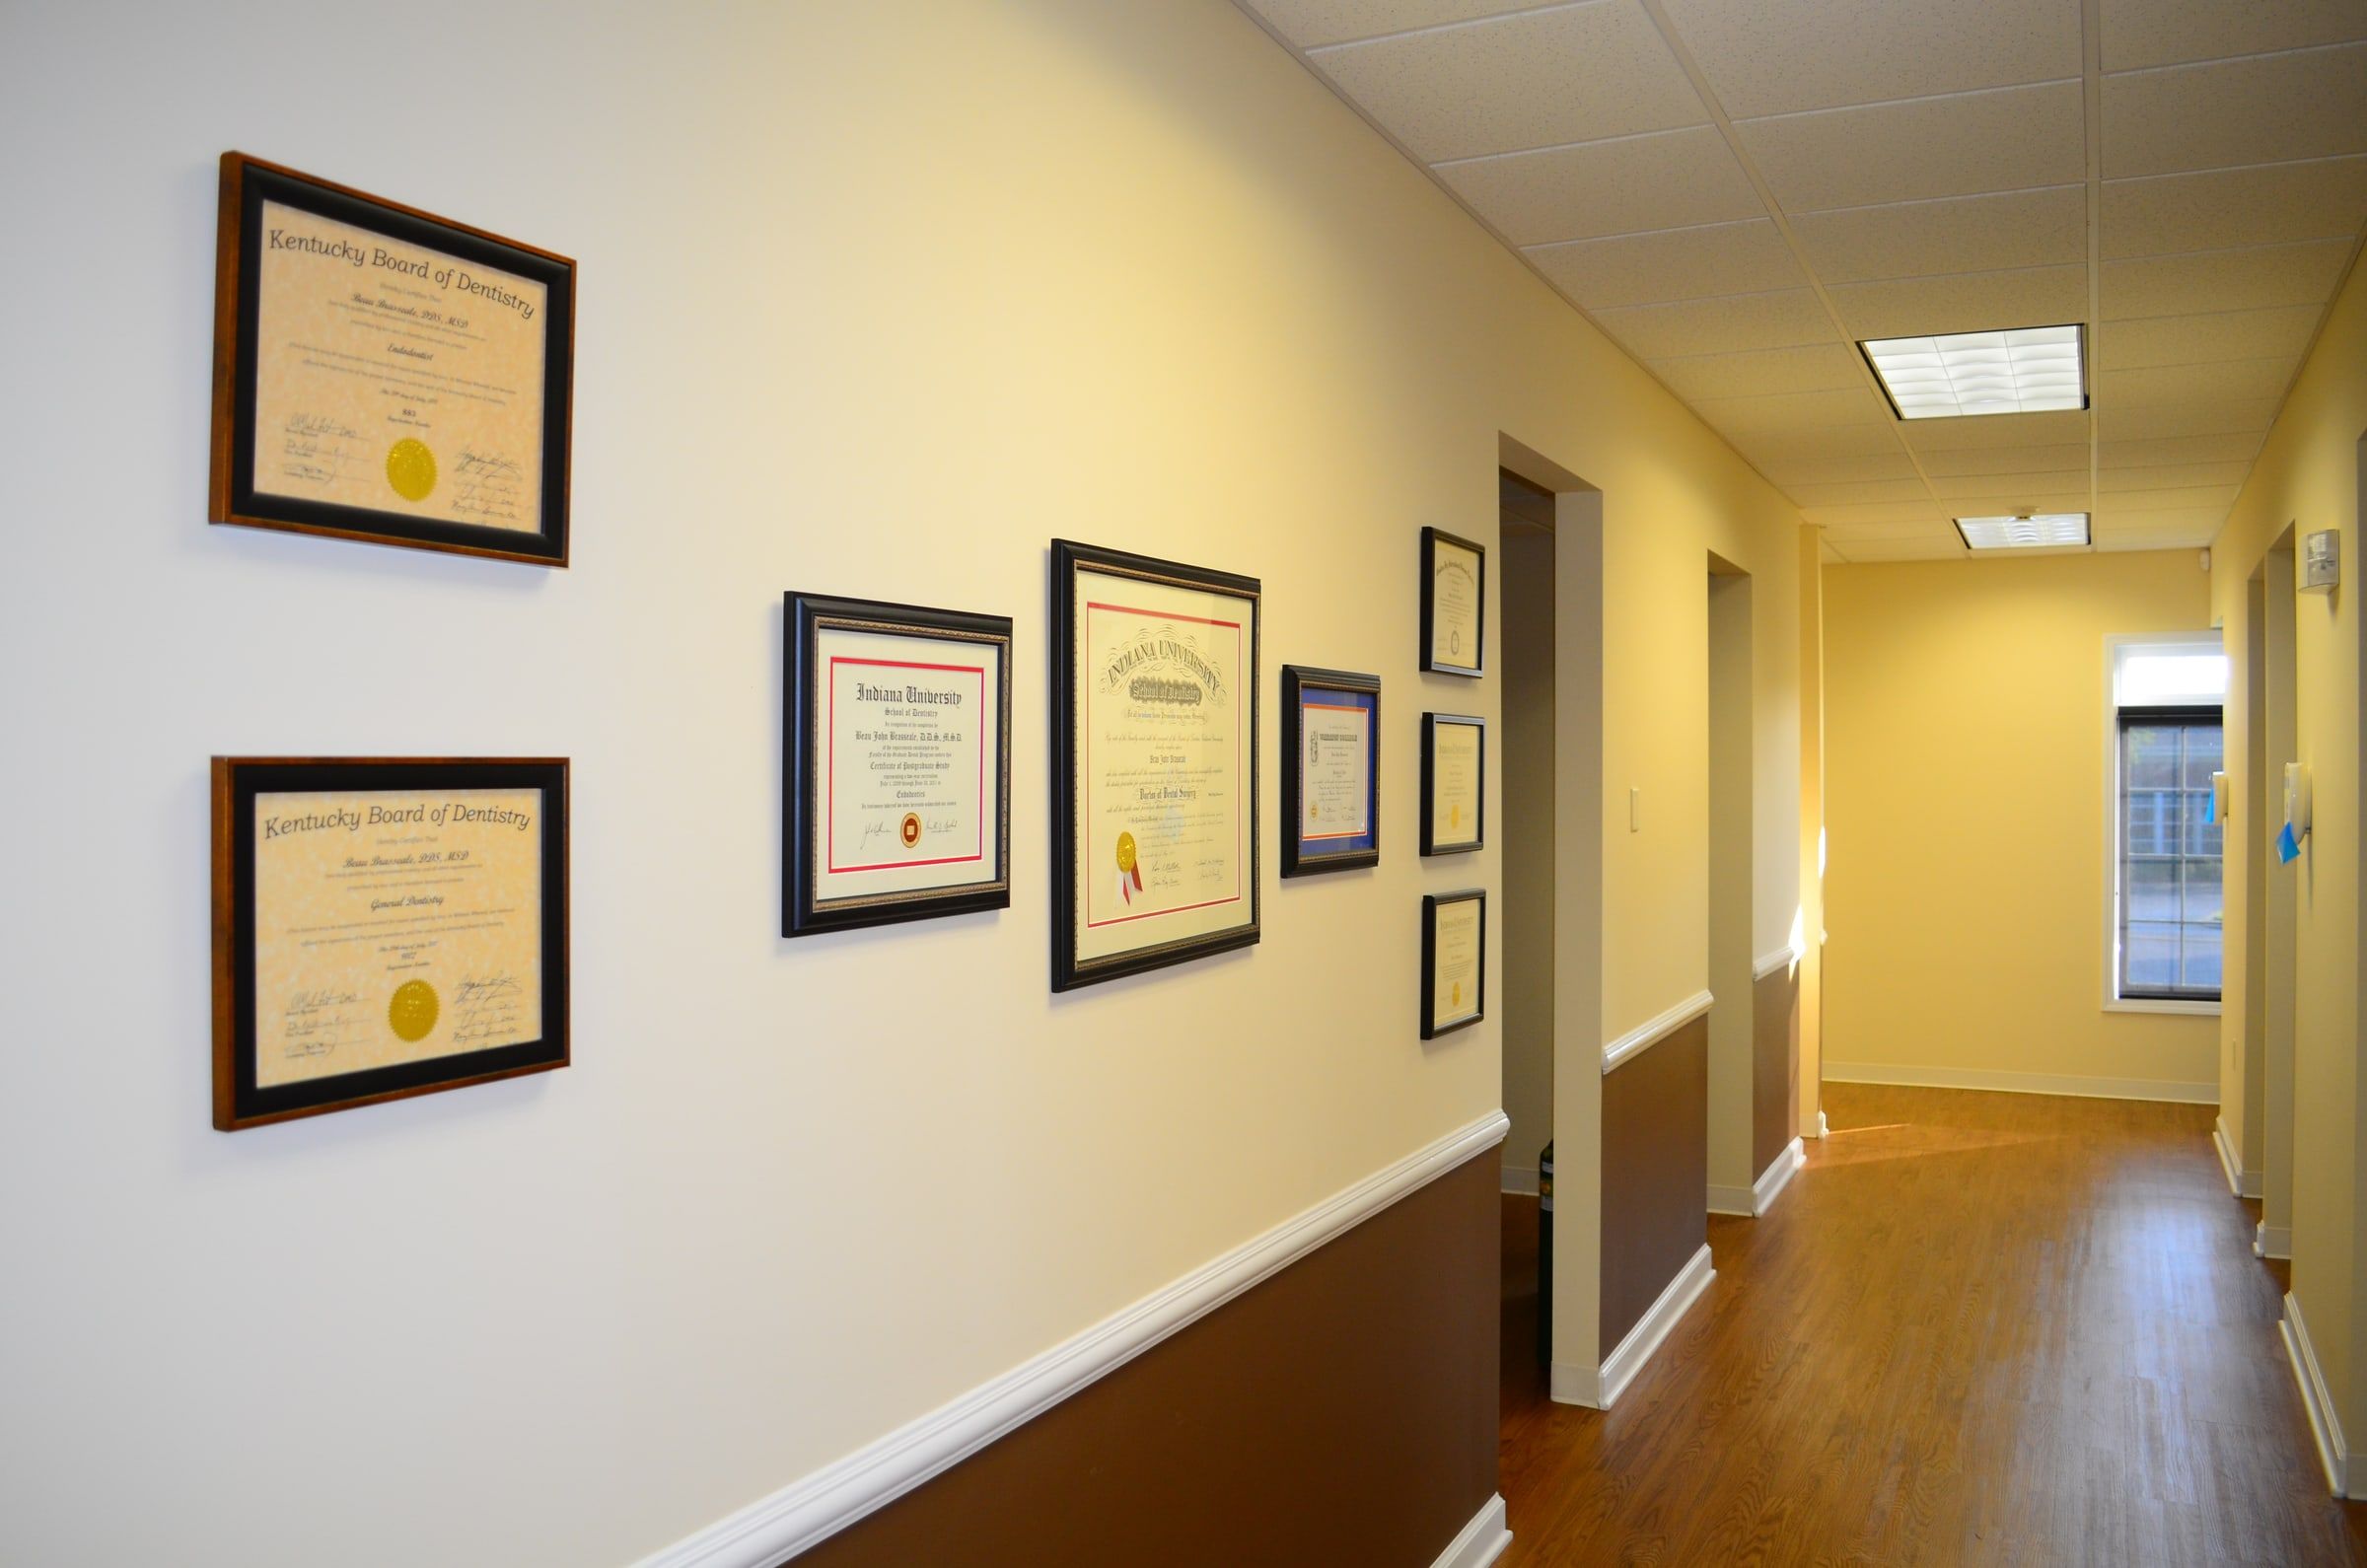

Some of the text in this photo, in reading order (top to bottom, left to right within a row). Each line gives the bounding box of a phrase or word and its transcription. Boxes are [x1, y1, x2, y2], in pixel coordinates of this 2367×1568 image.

[269, 228, 536, 320] Kentucky Board of Dentistry
[1108, 639, 1221, 692] INDIANA UNIVERSITY
[856, 682, 962, 708] Indiana University
[1132, 682, 1201, 704] School of Dentistry
[885, 707, 939, 719] School of Dentistry
[263, 804, 531, 841] Kentucky Board of Dentistry
[444, 850, 469, 861] MSD
[370, 895, 445, 912] General Dentistry
